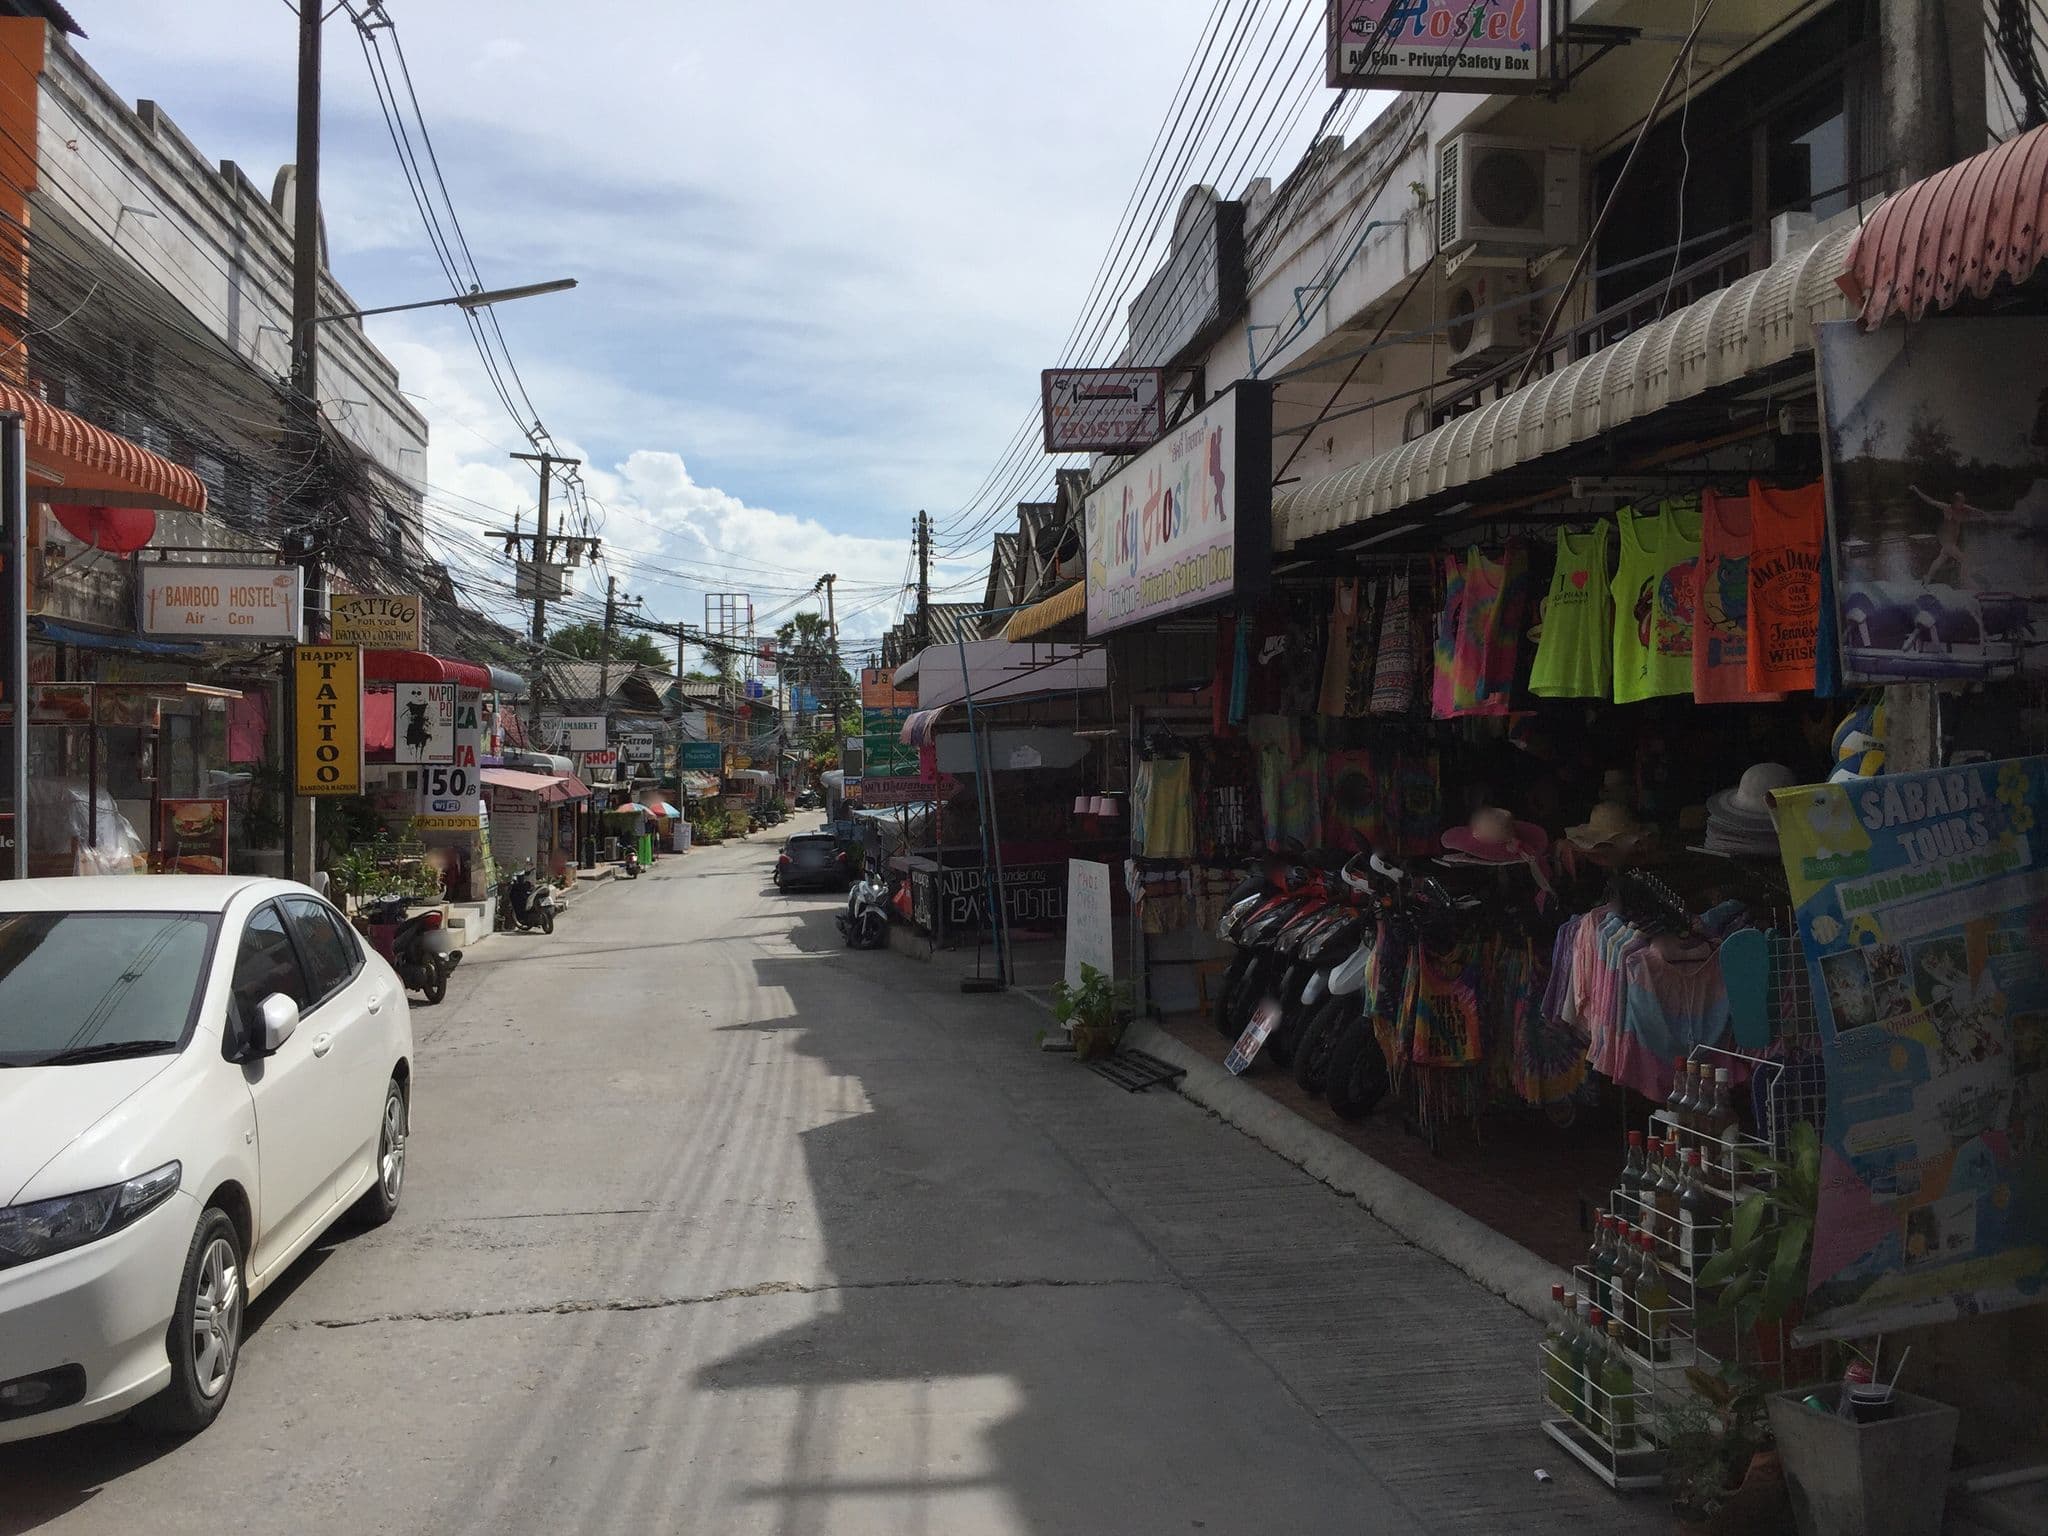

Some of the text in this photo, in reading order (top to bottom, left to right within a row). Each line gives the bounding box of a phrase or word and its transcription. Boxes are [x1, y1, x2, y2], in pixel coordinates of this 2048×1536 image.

[1385, 0, 1526, 41] Hostel
[1371, 50, 1398, 67] Con
[1408, 52, 1456, 68] Private
[1458, 53, 1501, 71] Safety
[1504, 55, 1530, 71] Box
[1059, 420, 1153, 439] HOSTEL
[1140, 566, 1173, 610] Private
[1173, 552, 1209, 596] Safety
[1209, 543, 1233, 587] Box
[1752, 559, 1786, 589] JACK
[166, 586, 277, 607] BAMBOO HOSTEL
[185, 611, 205, 625] Air
[228, 612, 255, 625] Con
[336, 597, 416, 624] TATTOO
[299, 651, 353, 662] HAPPY
[428, 686, 453, 702] NAPO
[315, 662, 341, 783] TATTOO
[439, 702, 453, 718] PO
[586, 751, 617, 765] SHOP
[1860, 768, 1987, 831] SABABA
[1896, 812, 1991, 869] TOURS
[935, 870, 981, 896] WILD
[1004, 886, 1066, 920] HOSTEL
